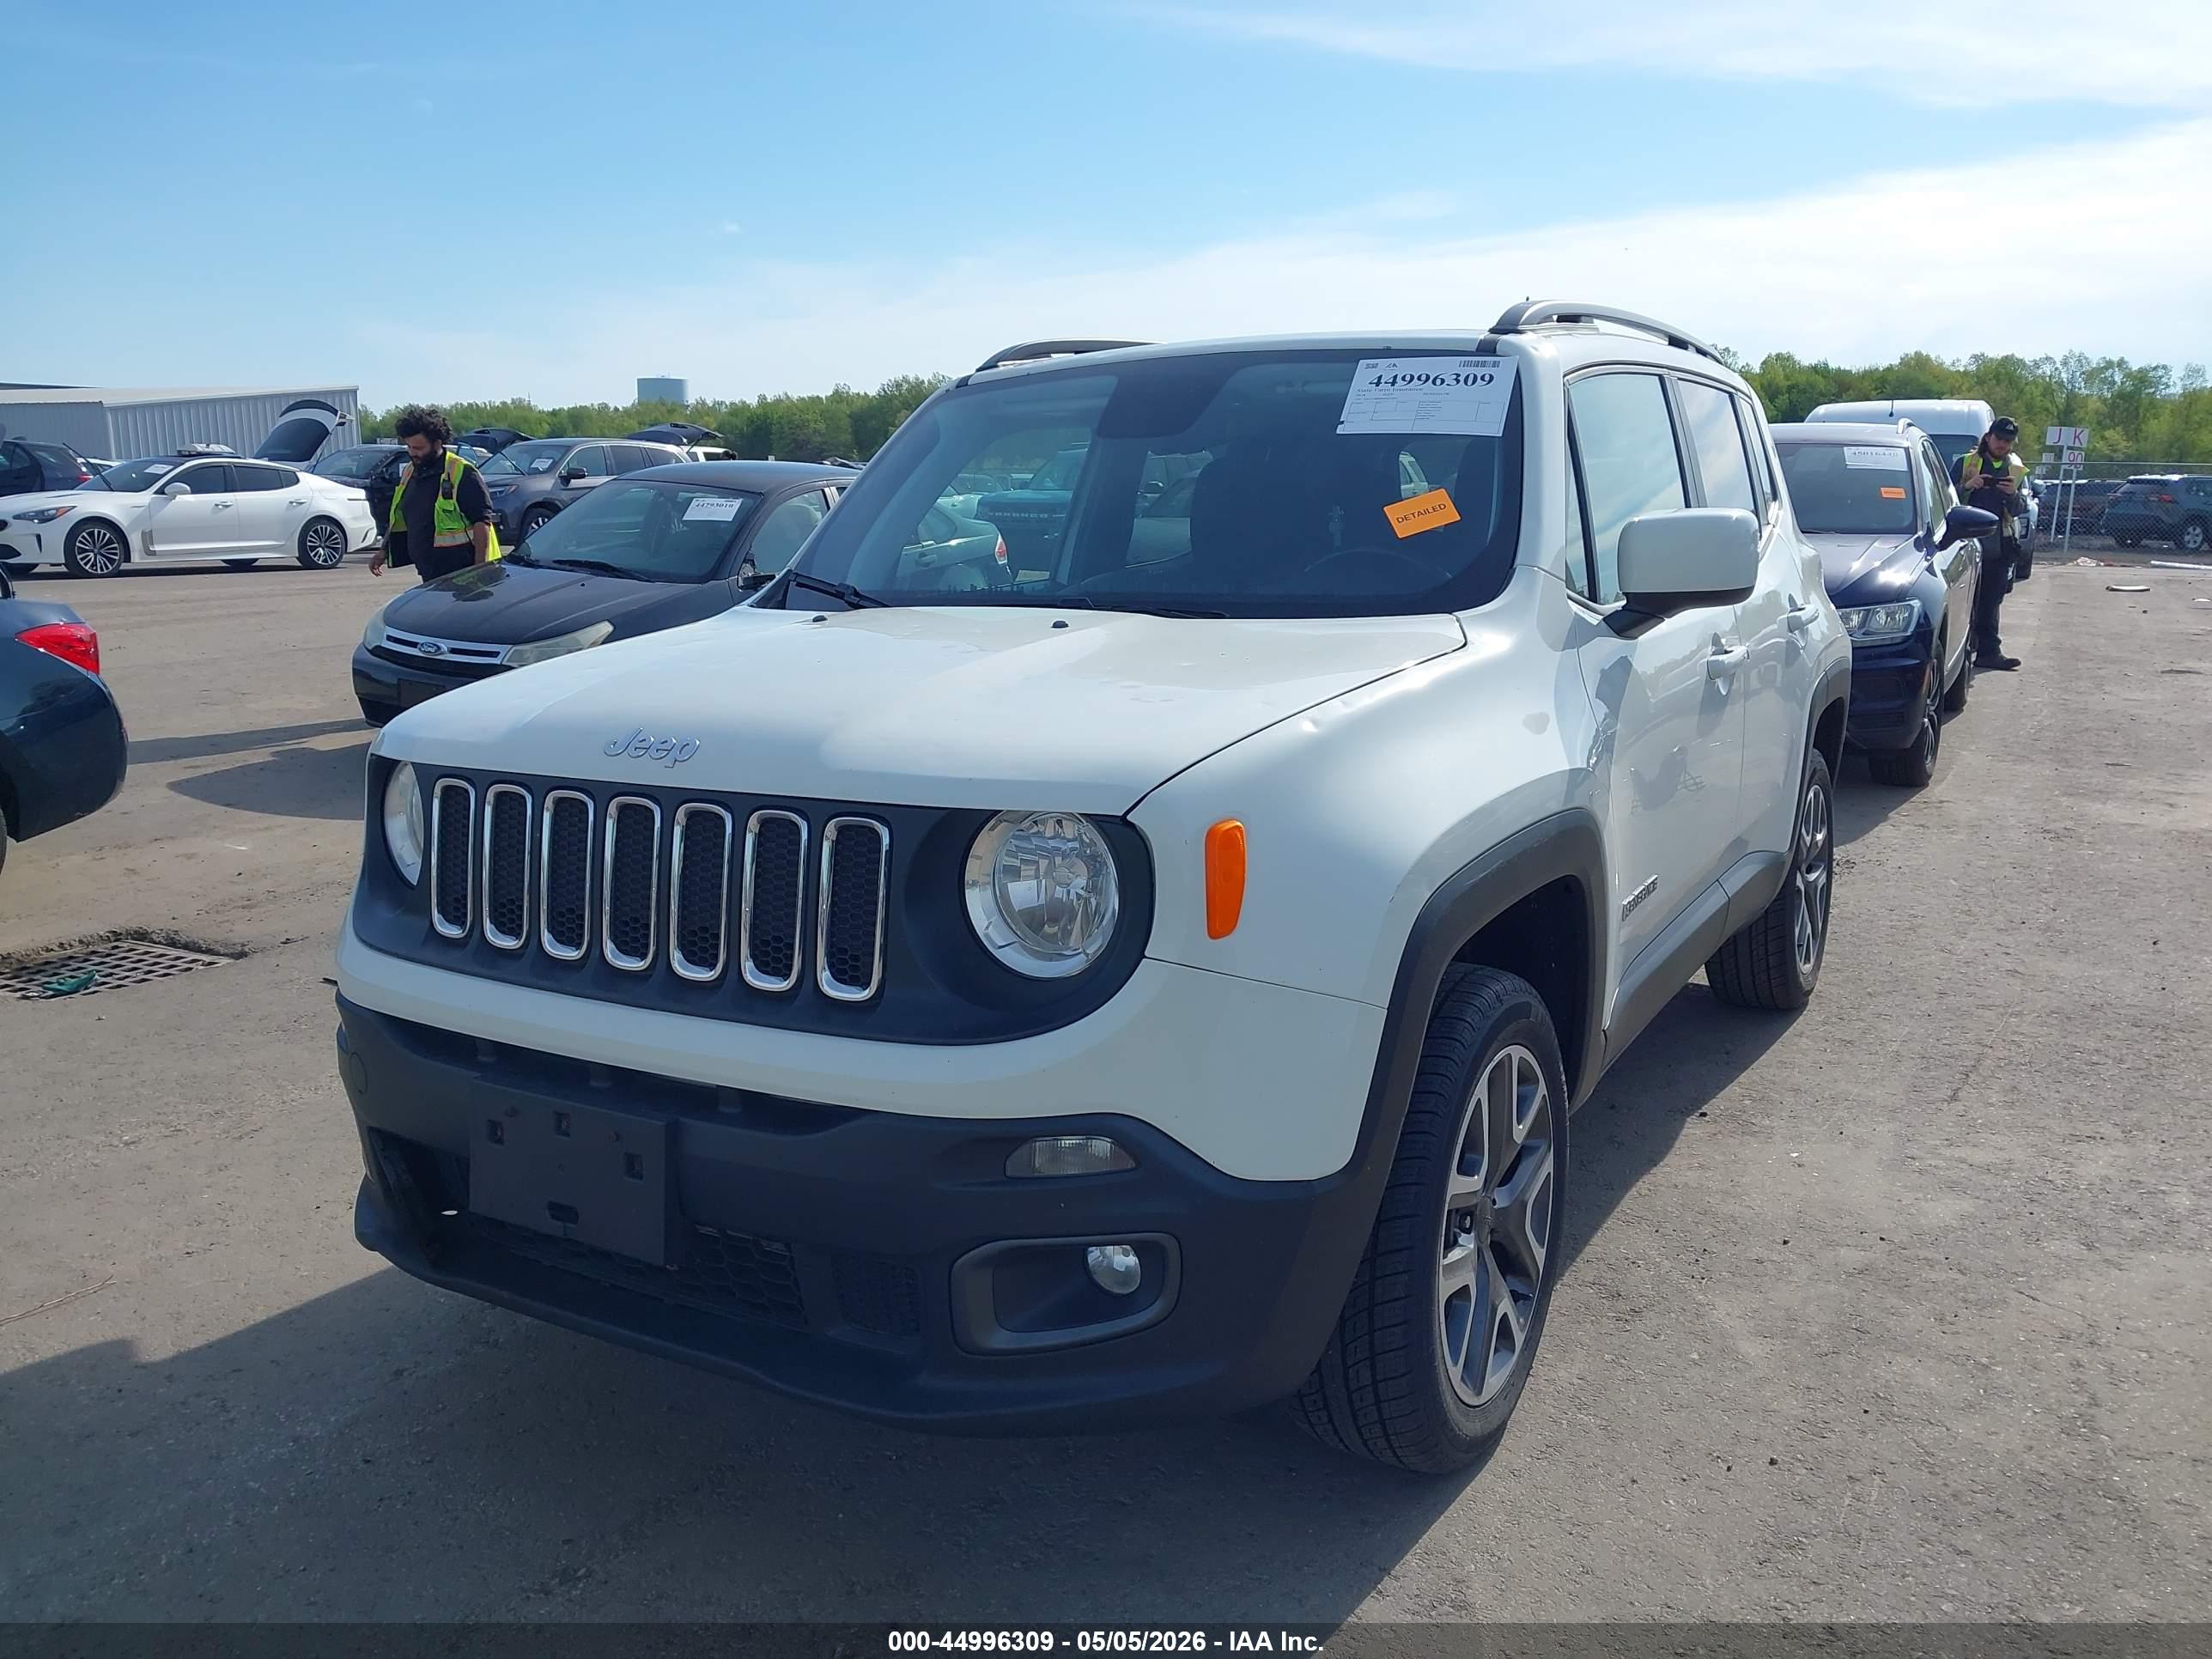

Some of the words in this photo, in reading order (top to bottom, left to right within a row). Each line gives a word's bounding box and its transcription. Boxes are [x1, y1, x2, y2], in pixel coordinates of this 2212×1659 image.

[1368, 372, 1495, 387] 44996309
[2053, 428, 2062, 445] J
[2073, 428, 2084, 446] K
[2067, 451, 2083, 469] 90
[1396, 502, 1447, 524] DETAILED
[604, 727, 701, 769] Jeep
